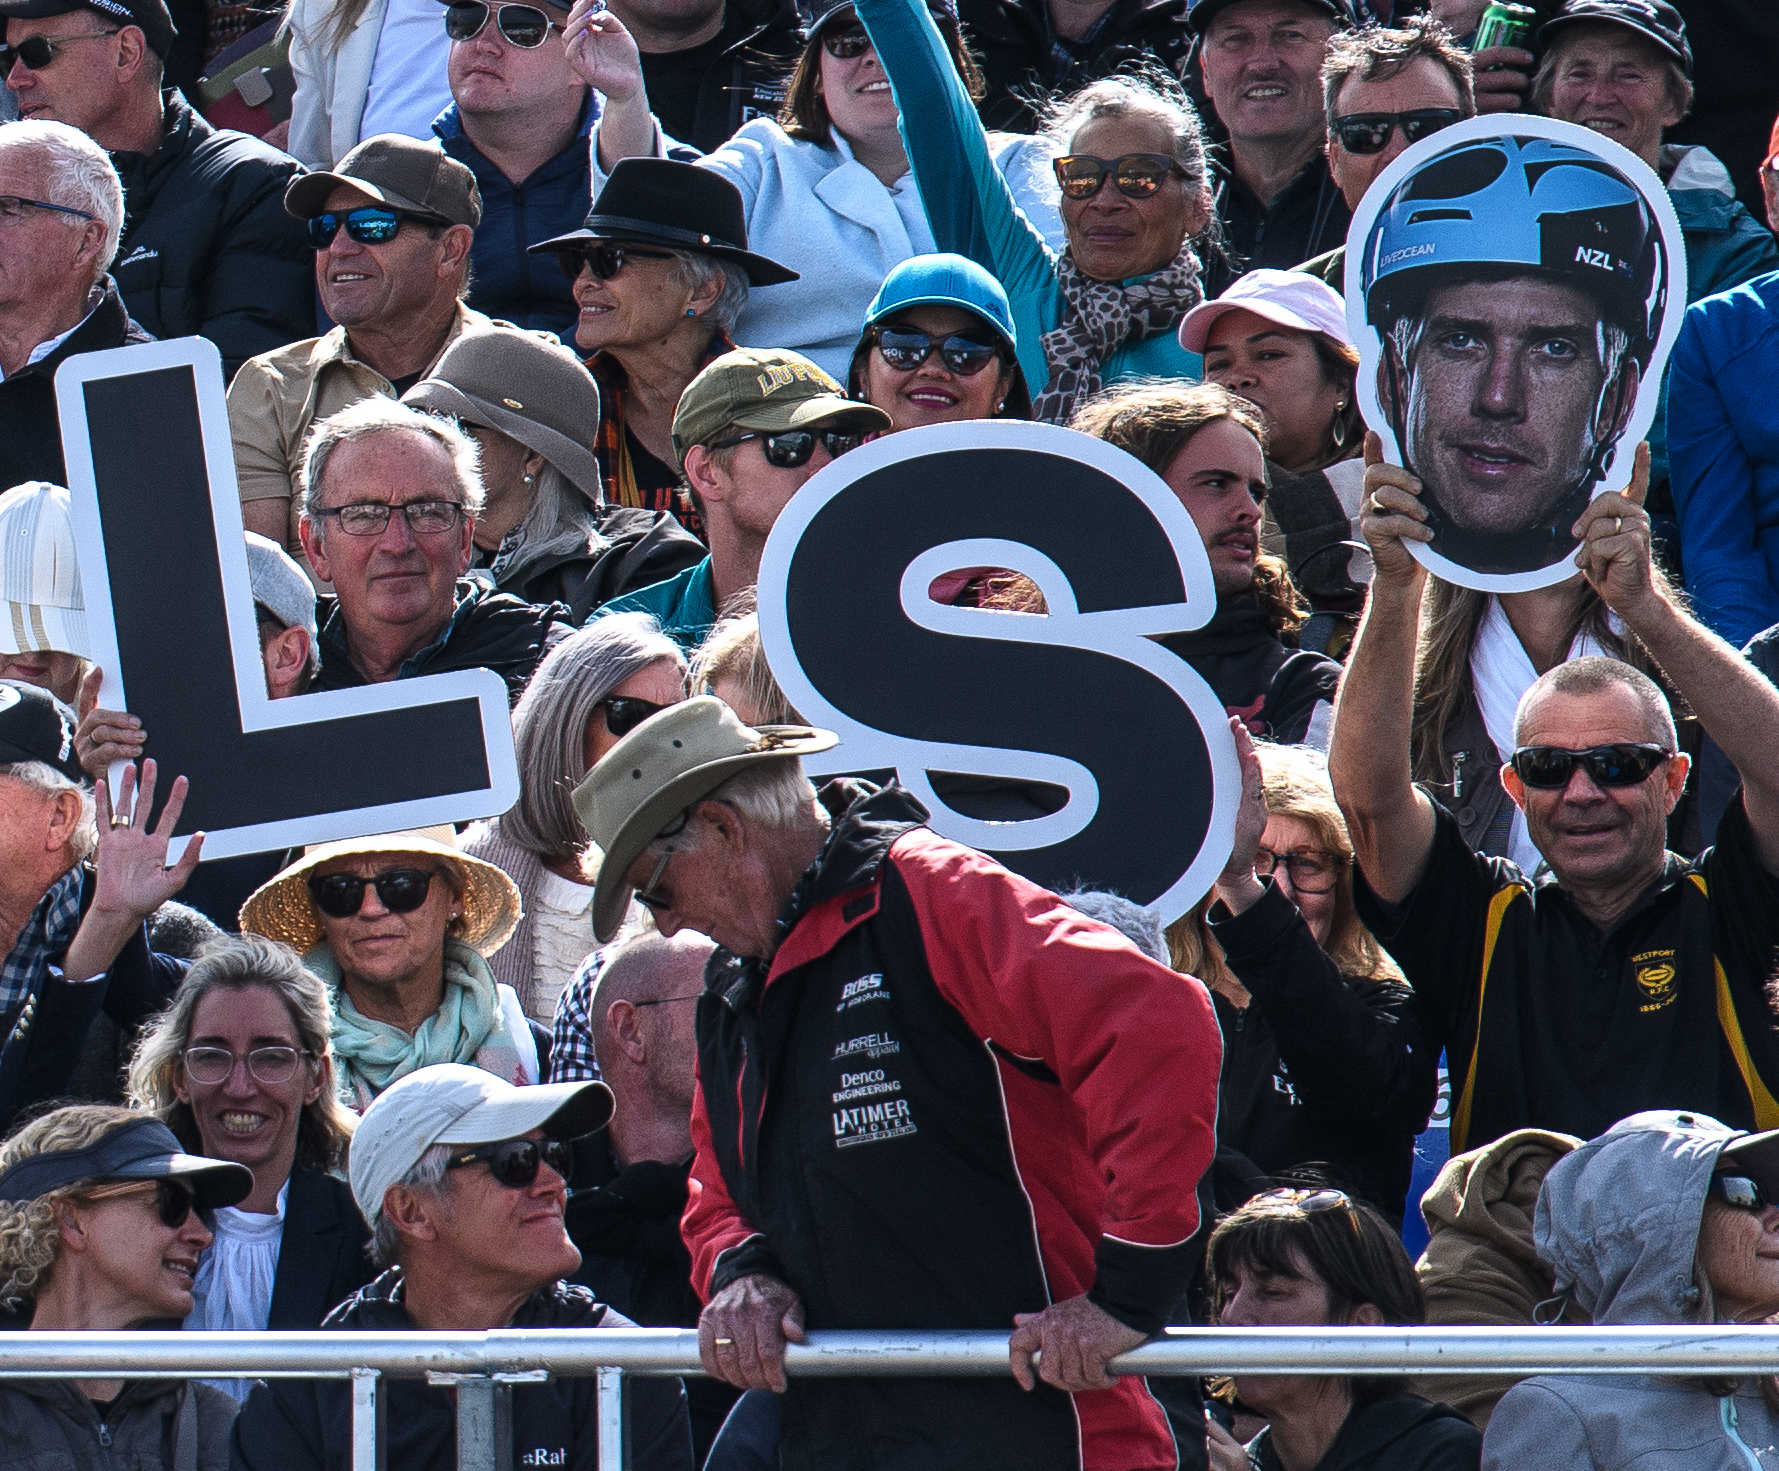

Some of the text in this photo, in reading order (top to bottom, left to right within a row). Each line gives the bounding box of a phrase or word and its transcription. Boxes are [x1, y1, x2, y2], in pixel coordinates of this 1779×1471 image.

[1379, 242, 1437, 271] LIVEOCEAN
[1574, 245, 1614, 271] NZL
[835, 1031, 896, 1057] HURRELL
[832, 1080, 902, 1104] ENGINEERING
[841, 1069, 885, 1089] Denco
[833, 1099, 911, 1136] LATIMER
[858, 1116, 914, 1135] HOTEL
